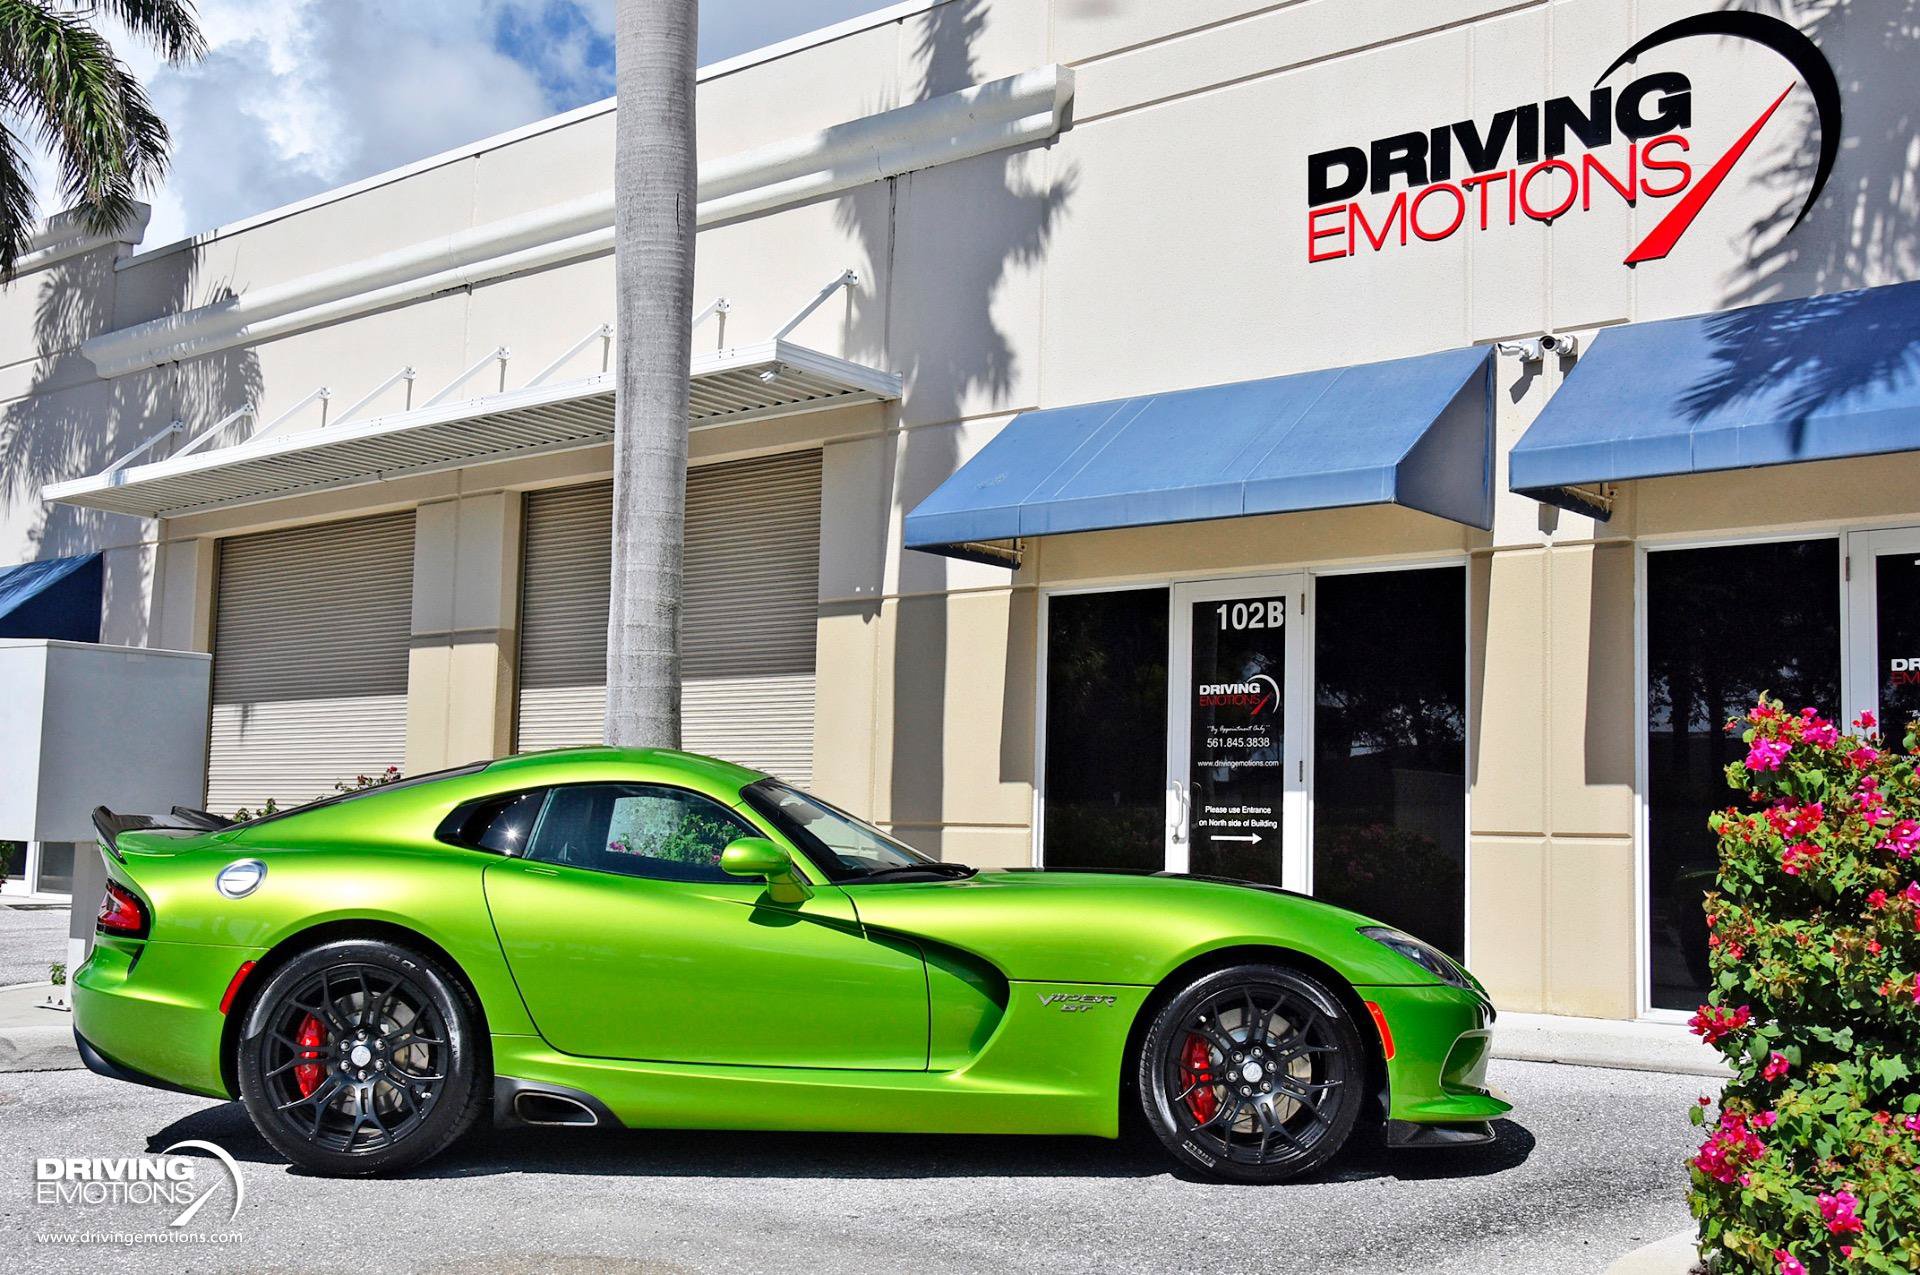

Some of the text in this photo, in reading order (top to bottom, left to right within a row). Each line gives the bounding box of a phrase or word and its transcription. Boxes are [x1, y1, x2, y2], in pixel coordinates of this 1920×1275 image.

[1308, 71, 1692, 207] DRIVING
[1308, 135, 1692, 263] EMOTIONS
[1216, 601, 1284, 630] 102B
[1199, 683, 1260, 695] DRIVING
[1199, 695, 1260, 707] EMOTIONS
[1219, 725, 1253, 734] Appointment
[1207, 737, 1270, 748] 561.845.3838
[1197, 760, 1279, 769] www.drivingemotions.com
[1205, 806, 1227, 814] Please
[1241, 805, 1272, 815] Entrance
[1209, 818, 1227, 827] North
[1228, 819, 1242, 827] side
[1243, 819, 1250, 827] of
[1251, 819, 1279, 830] Building
[1036, 992, 1117, 1007] VIPER
